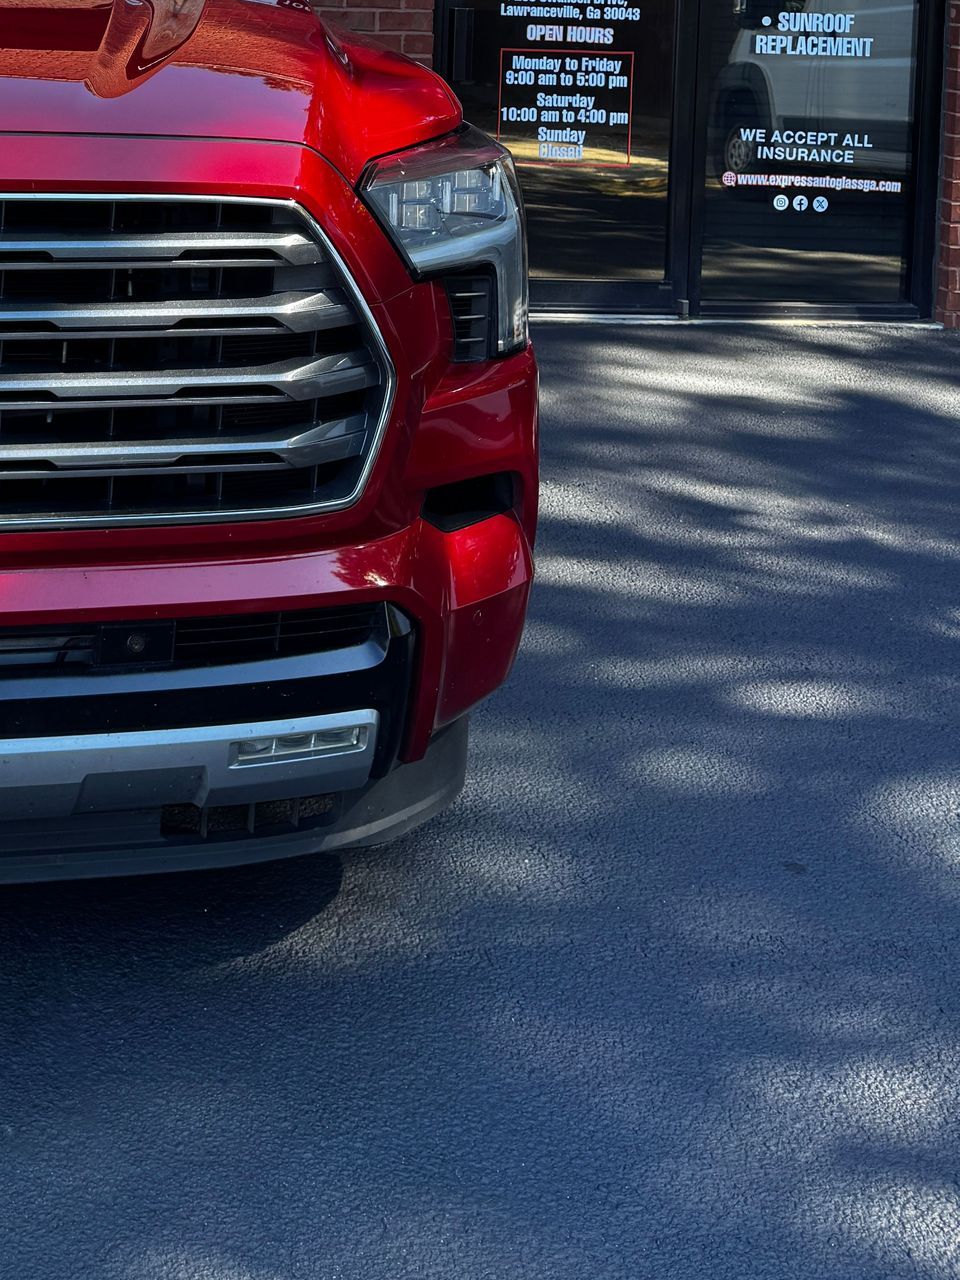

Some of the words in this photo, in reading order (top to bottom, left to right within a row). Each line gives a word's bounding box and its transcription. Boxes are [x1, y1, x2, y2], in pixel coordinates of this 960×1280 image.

[500, 3, 584, 20] Lawranceville,
[586, 6, 601, 19] Ga
[604, 7, 640, 21] 30043
[777, 12, 855, 33] SUNROOF
[526, 24, 564, 42] OPEN
[566, 26, 614, 44] HOURS
[755, 35, 873, 57] REPLACEMENT
[512, 55, 562, 72] Monday
[565, 57, 578, 71] to
[581, 57, 622, 74] Friday
[505, 70, 535, 85] 9:00
[538, 74, 557, 86] am
[560, 72, 573, 86] to
[576, 72, 605, 87] 5:00
[608, 75, 628, 89] pm
[536, 92, 595, 110] Saturday
[501, 107, 537, 122] 10:00
[540, 110, 559, 123] am
[562, 109, 575, 123] to
[577, 109, 606, 124] 4:00
[609, 111, 628, 126] pm
[538, 126, 586, 144] Sunday
[740, 128, 766, 142] WE
[770, 129, 838, 146] ACCEPT
[842, 133, 873, 148] ALL
[757, 146, 855, 164] INSURANCE
[737, 173, 902, 193] www.expressautoglassga.com
